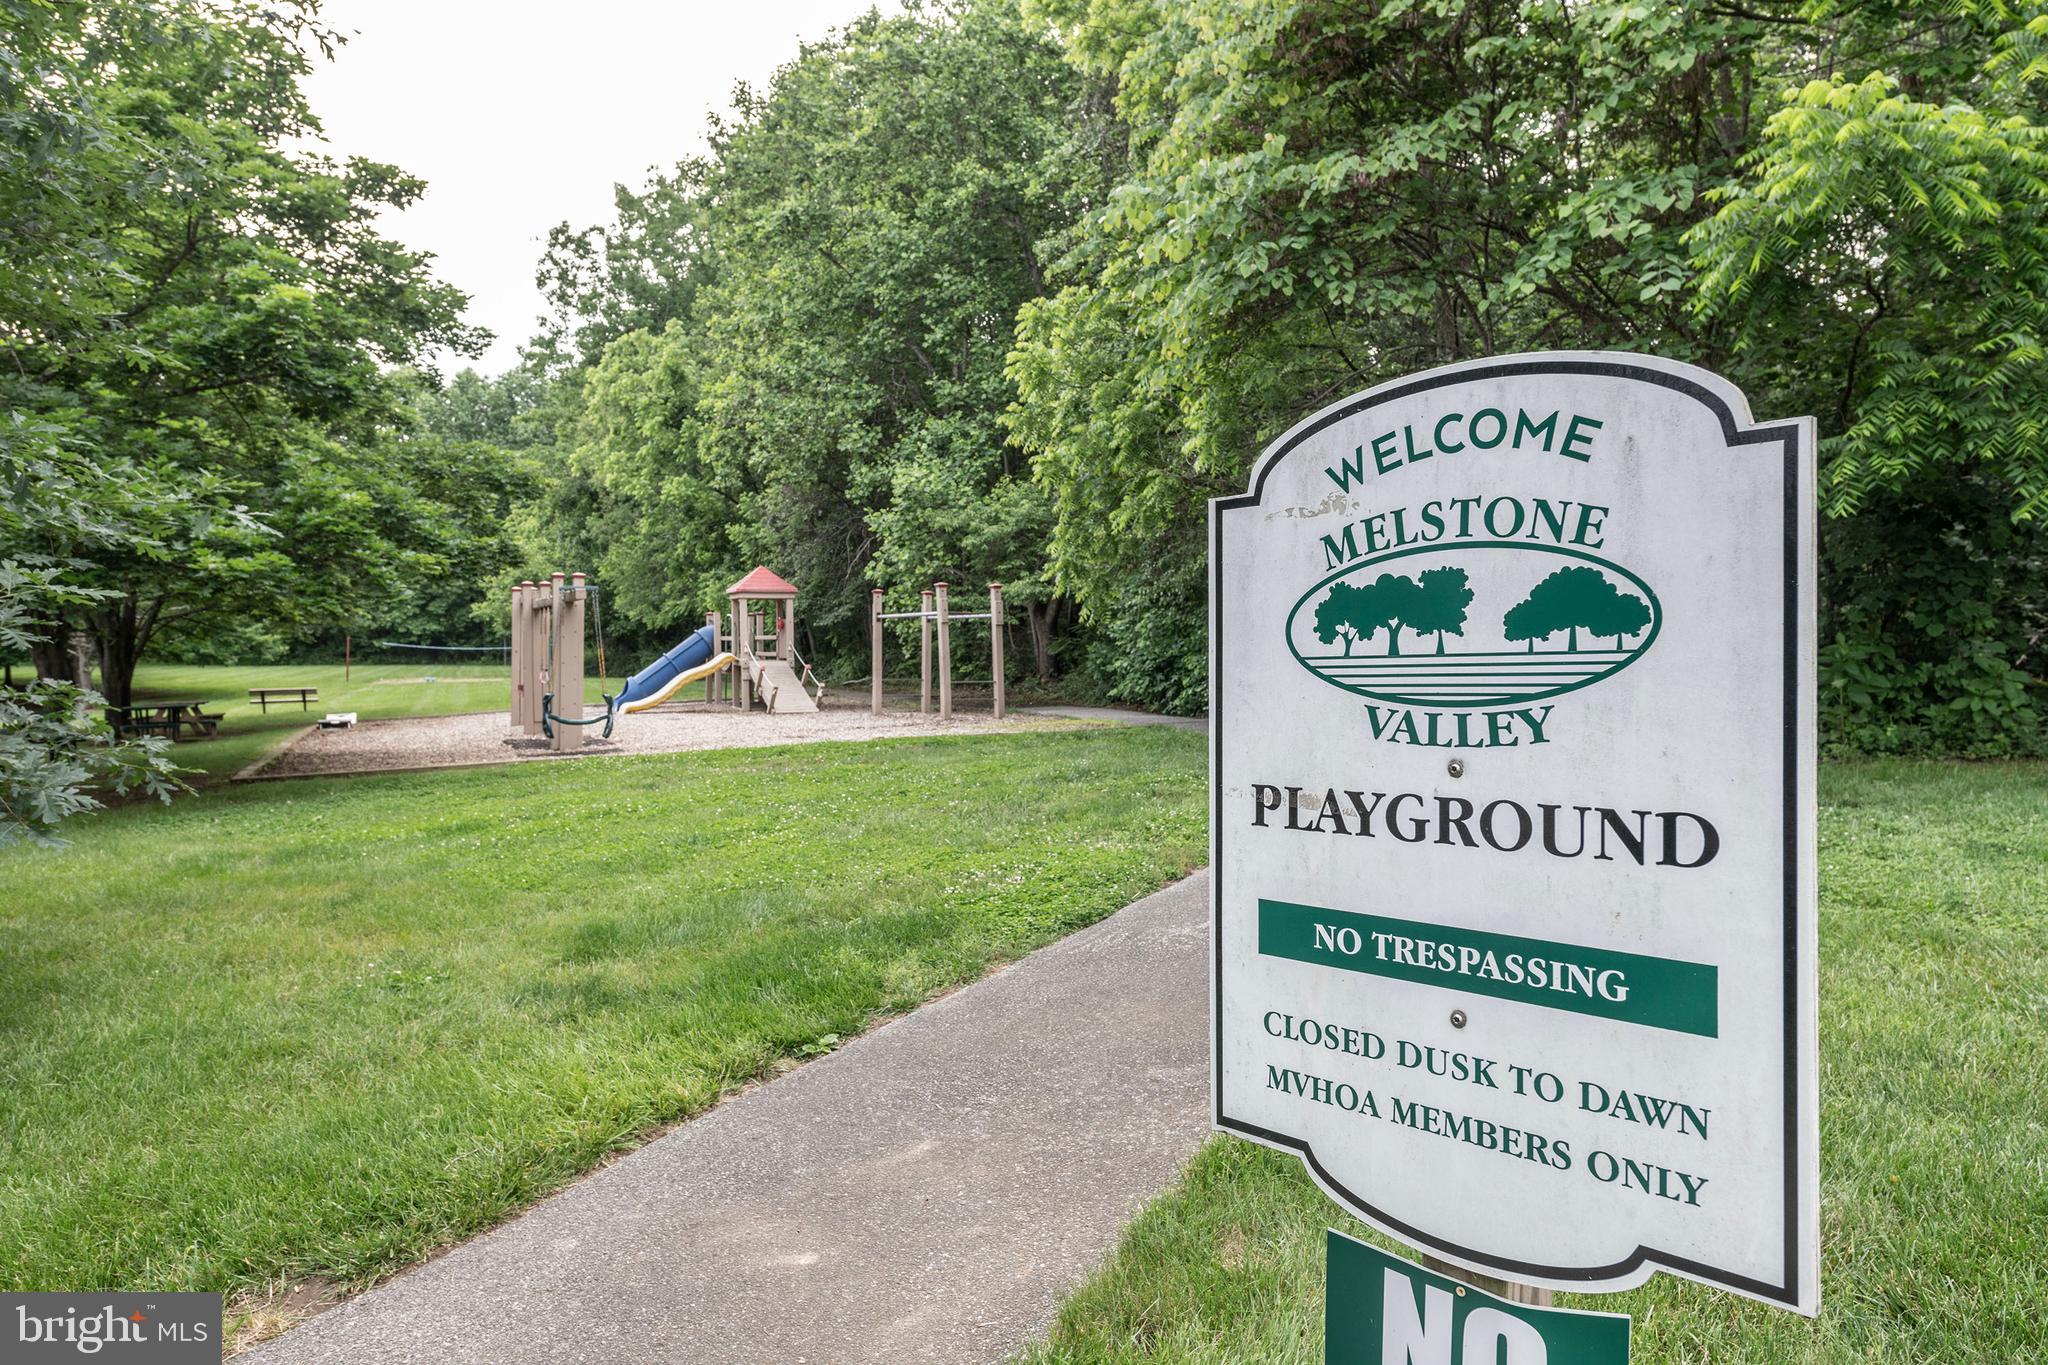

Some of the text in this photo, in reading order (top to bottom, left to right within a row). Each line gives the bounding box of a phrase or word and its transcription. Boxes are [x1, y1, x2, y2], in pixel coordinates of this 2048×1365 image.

[1324, 407, 1604, 494] WELCOME
[1319, 496, 1610, 571] MELSTONE
[1364, 704, 1555, 748] VALLEY
[1251, 783, 1720, 868] PLAYGROUND
[1313, 923, 1630, 1003] NO TRESPASSING
[1262, 1010, 1711, 1141] CLOSED DUSK TO DAWN
[1265, 1063, 1709, 1207] MVHOA MEMBERS ONLY
